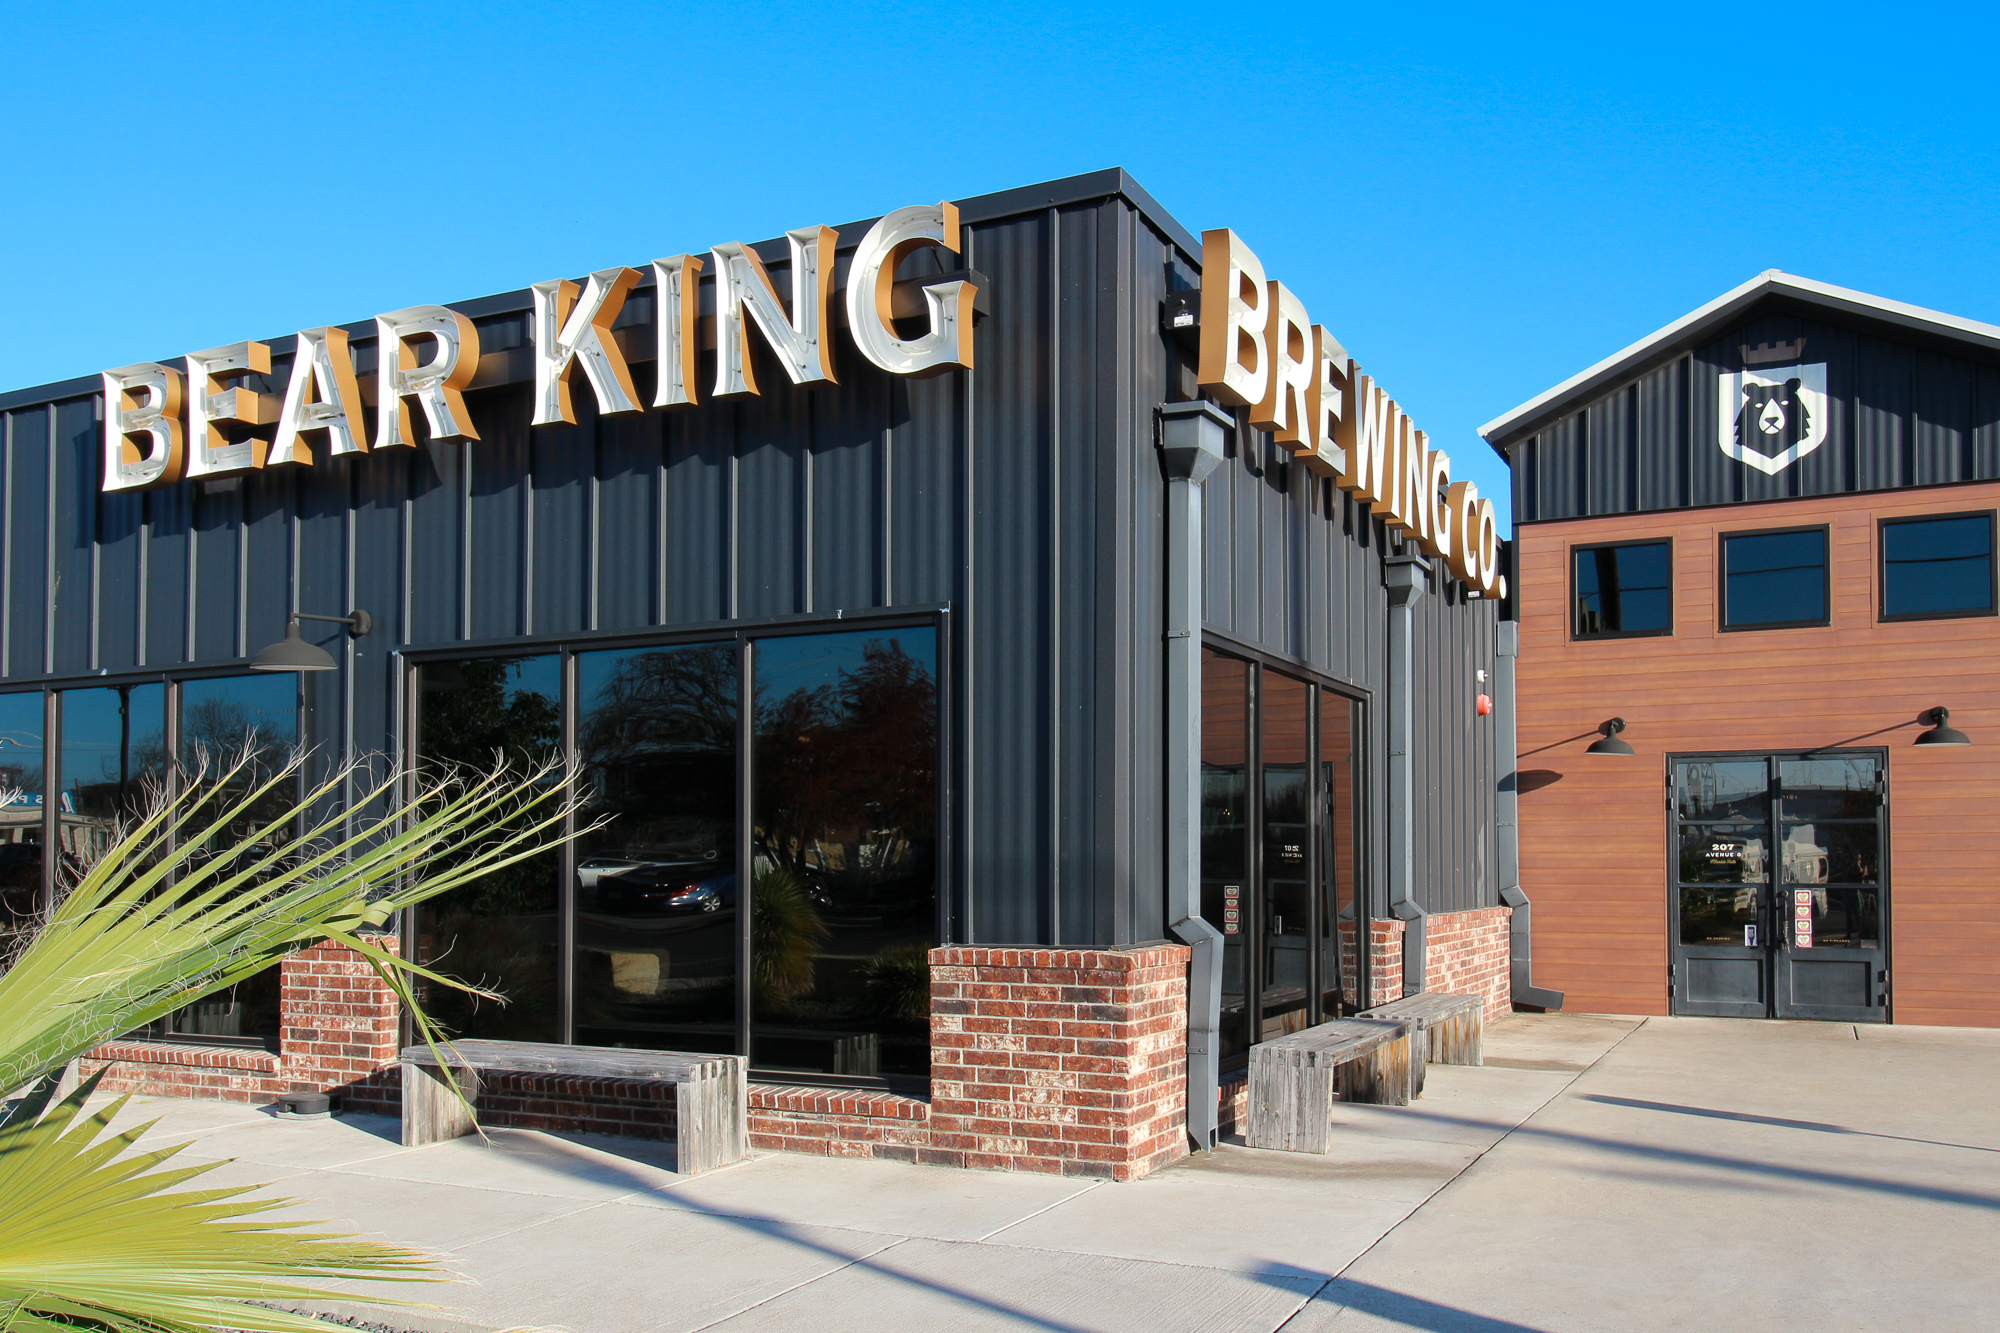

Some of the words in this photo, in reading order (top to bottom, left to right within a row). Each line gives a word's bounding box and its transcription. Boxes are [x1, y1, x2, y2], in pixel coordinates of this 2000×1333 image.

[101, 303, 481, 493] BEAR
[530, 201, 978, 427] KING
[1197, 228, 1452, 559] BREWING
[1446, 480, 1507, 600] CO.
